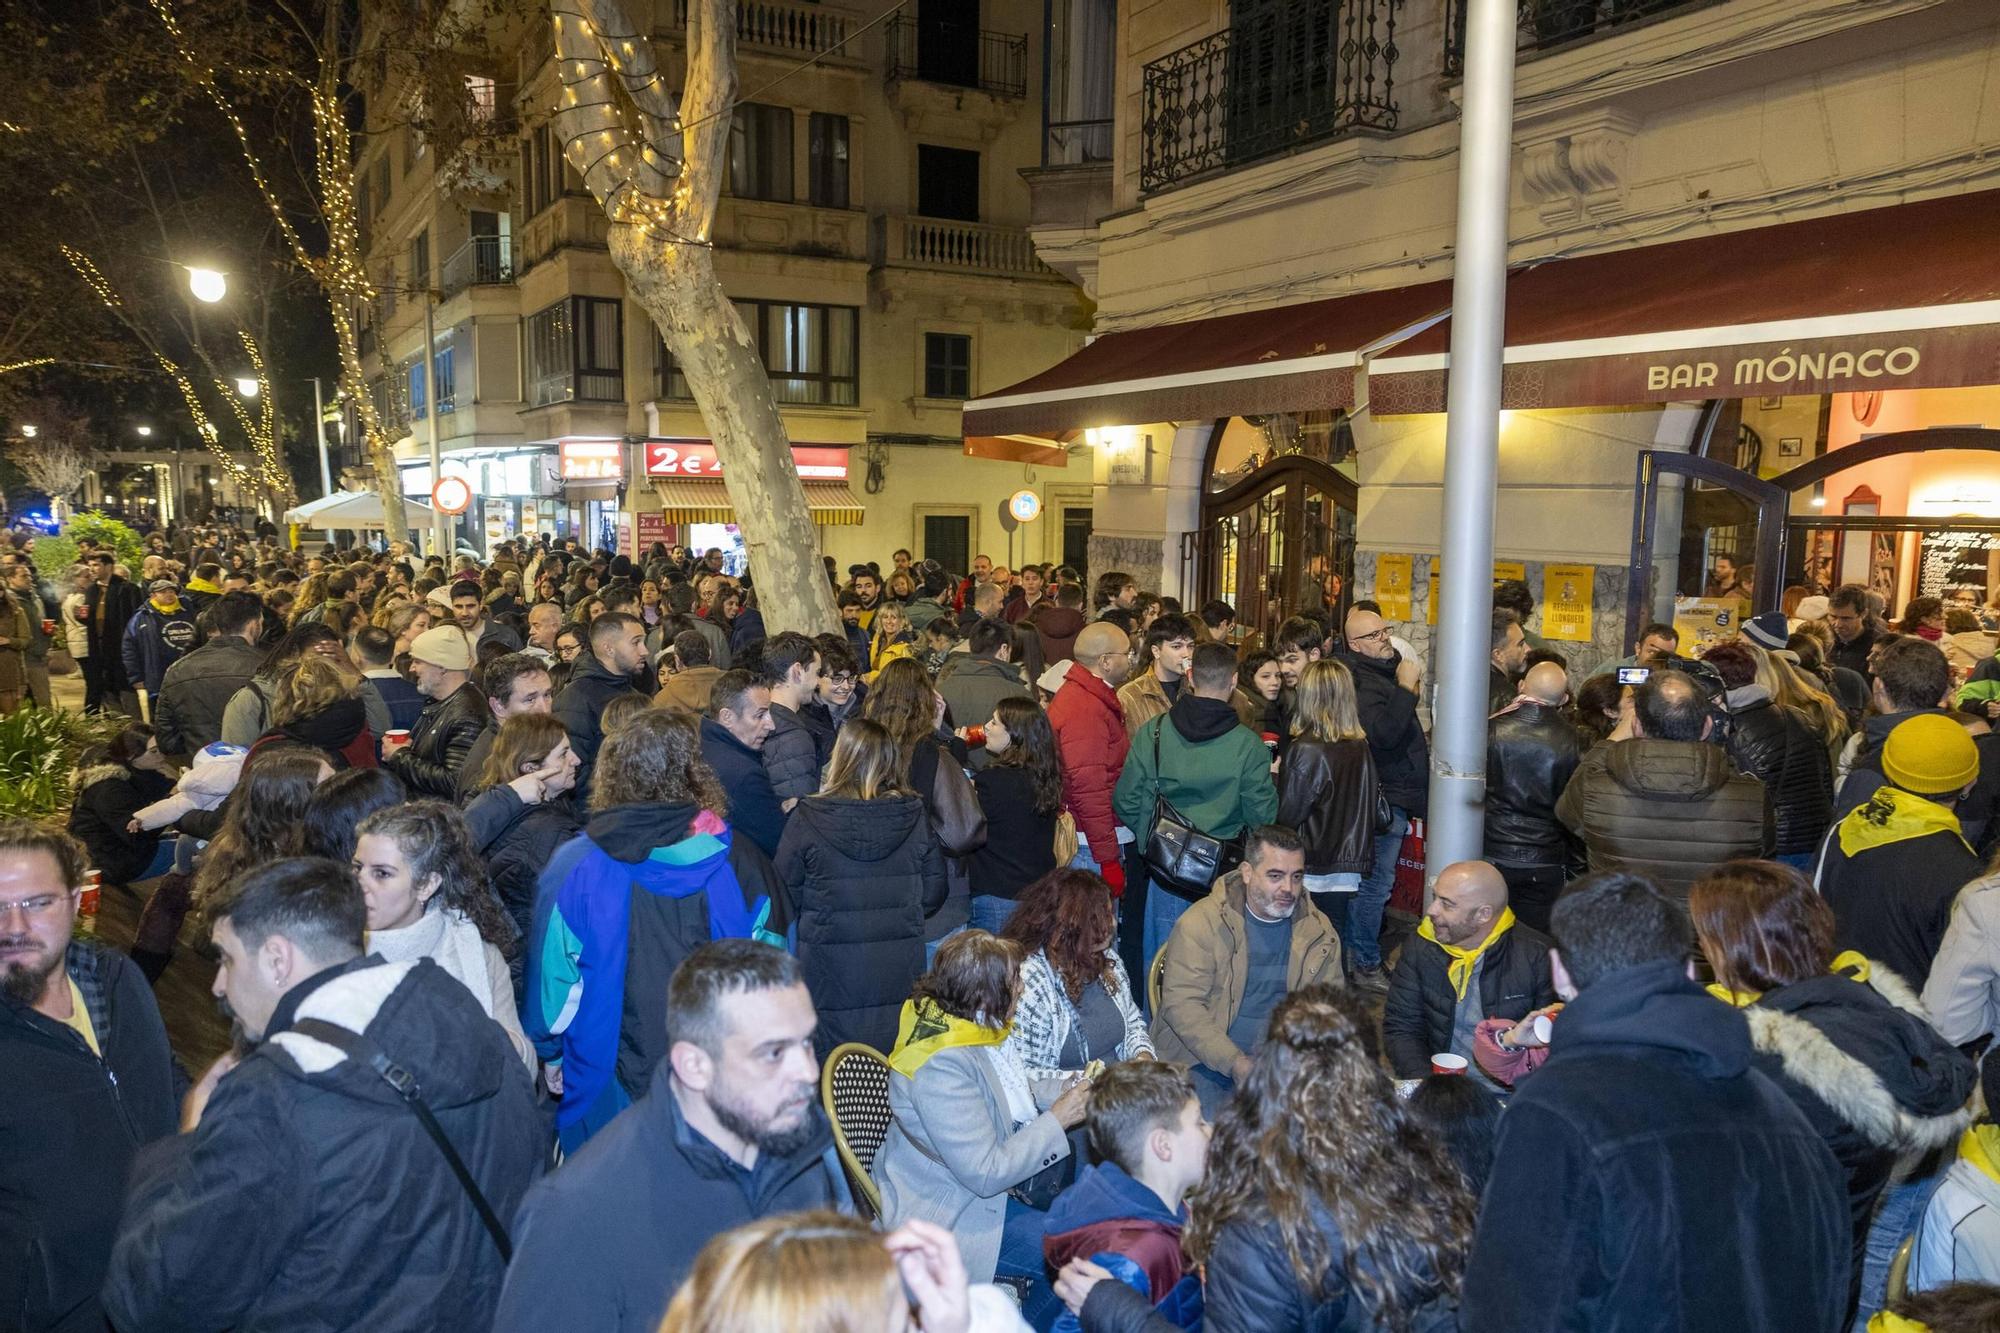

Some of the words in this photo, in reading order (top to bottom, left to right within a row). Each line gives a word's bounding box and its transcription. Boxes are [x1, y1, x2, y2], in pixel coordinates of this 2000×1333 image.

[1648, 362, 1718, 390] BAR
[1734, 346, 1920, 385] MÓNACO
[650, 447, 702, 473] 2€
